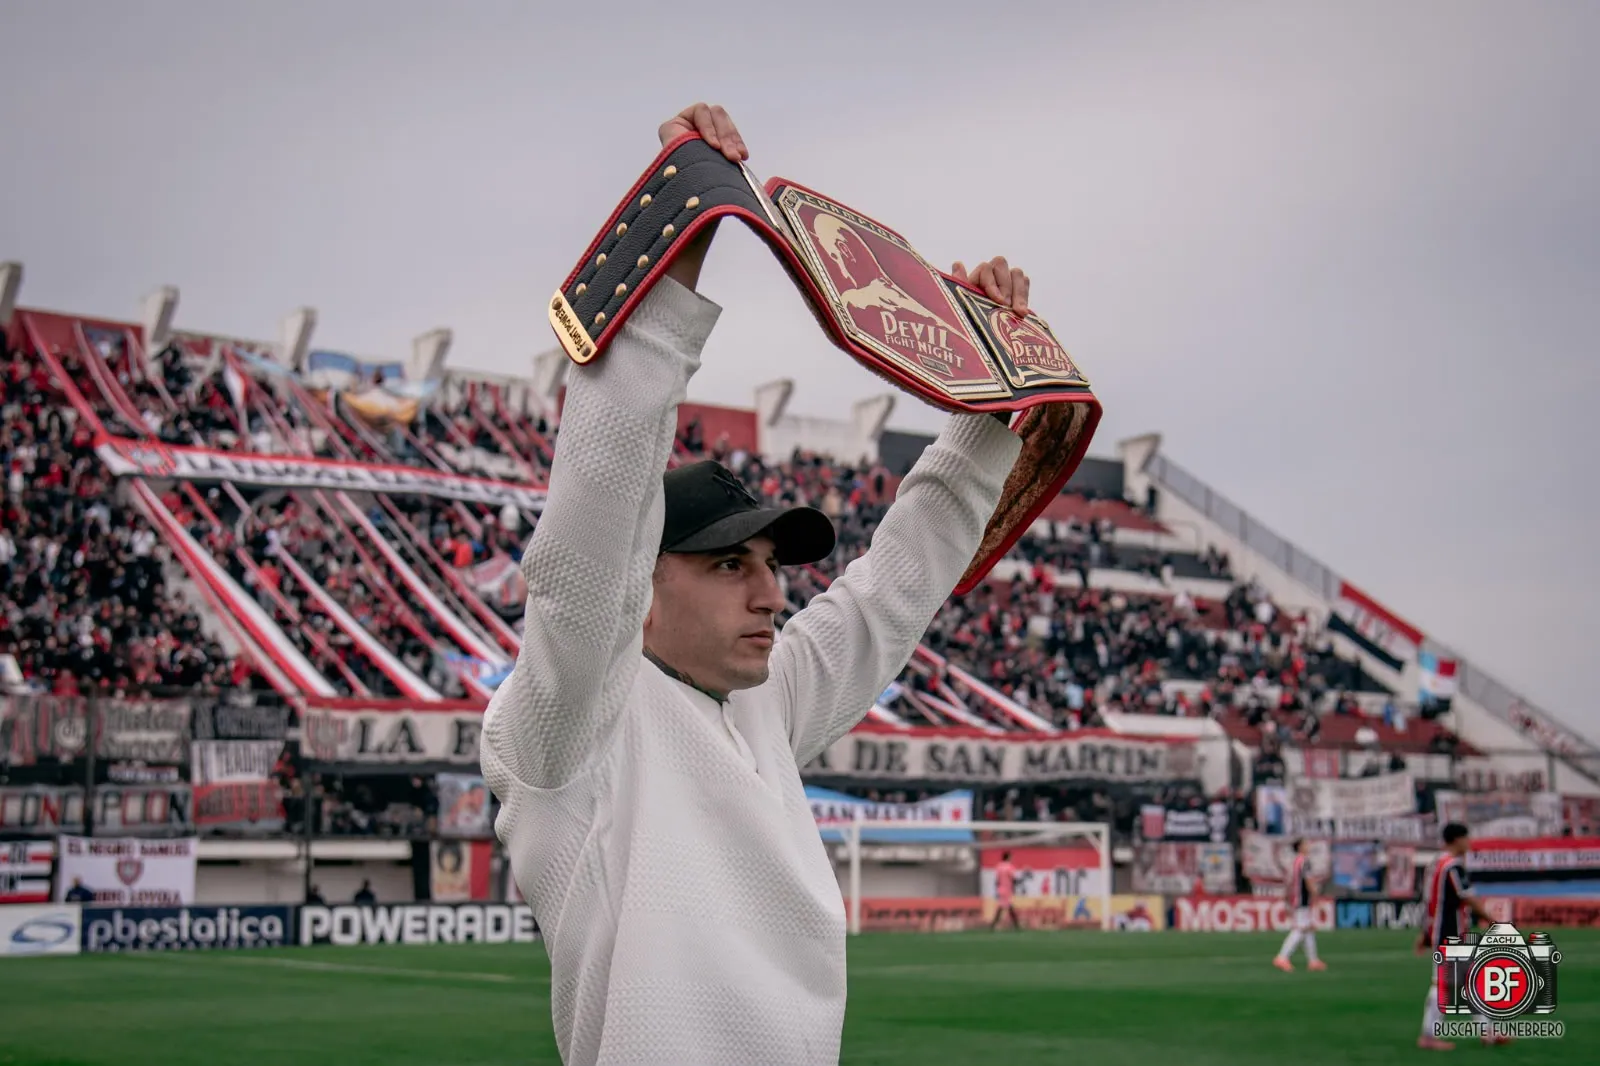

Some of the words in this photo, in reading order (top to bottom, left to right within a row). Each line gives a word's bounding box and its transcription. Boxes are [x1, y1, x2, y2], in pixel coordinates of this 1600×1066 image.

[804, 194, 900, 247] CHAMPION
[880, 310, 953, 351] DEVIL
[885, 334, 915, 349] FIGHT
[917, 341, 964, 368] NIGHT
[1012, 341, 1065, 363] DEVIL
[1039, 360, 1073, 373] NIGHT
[357, 716, 424, 754] LA
[855, 739, 907, 773] DE
[926, 743, 1005, 776] SAN
[1024, 744, 1162, 776] MARTIN
[87, 908, 284, 951] pbestatica
[302, 905, 535, 945] POWERADE
